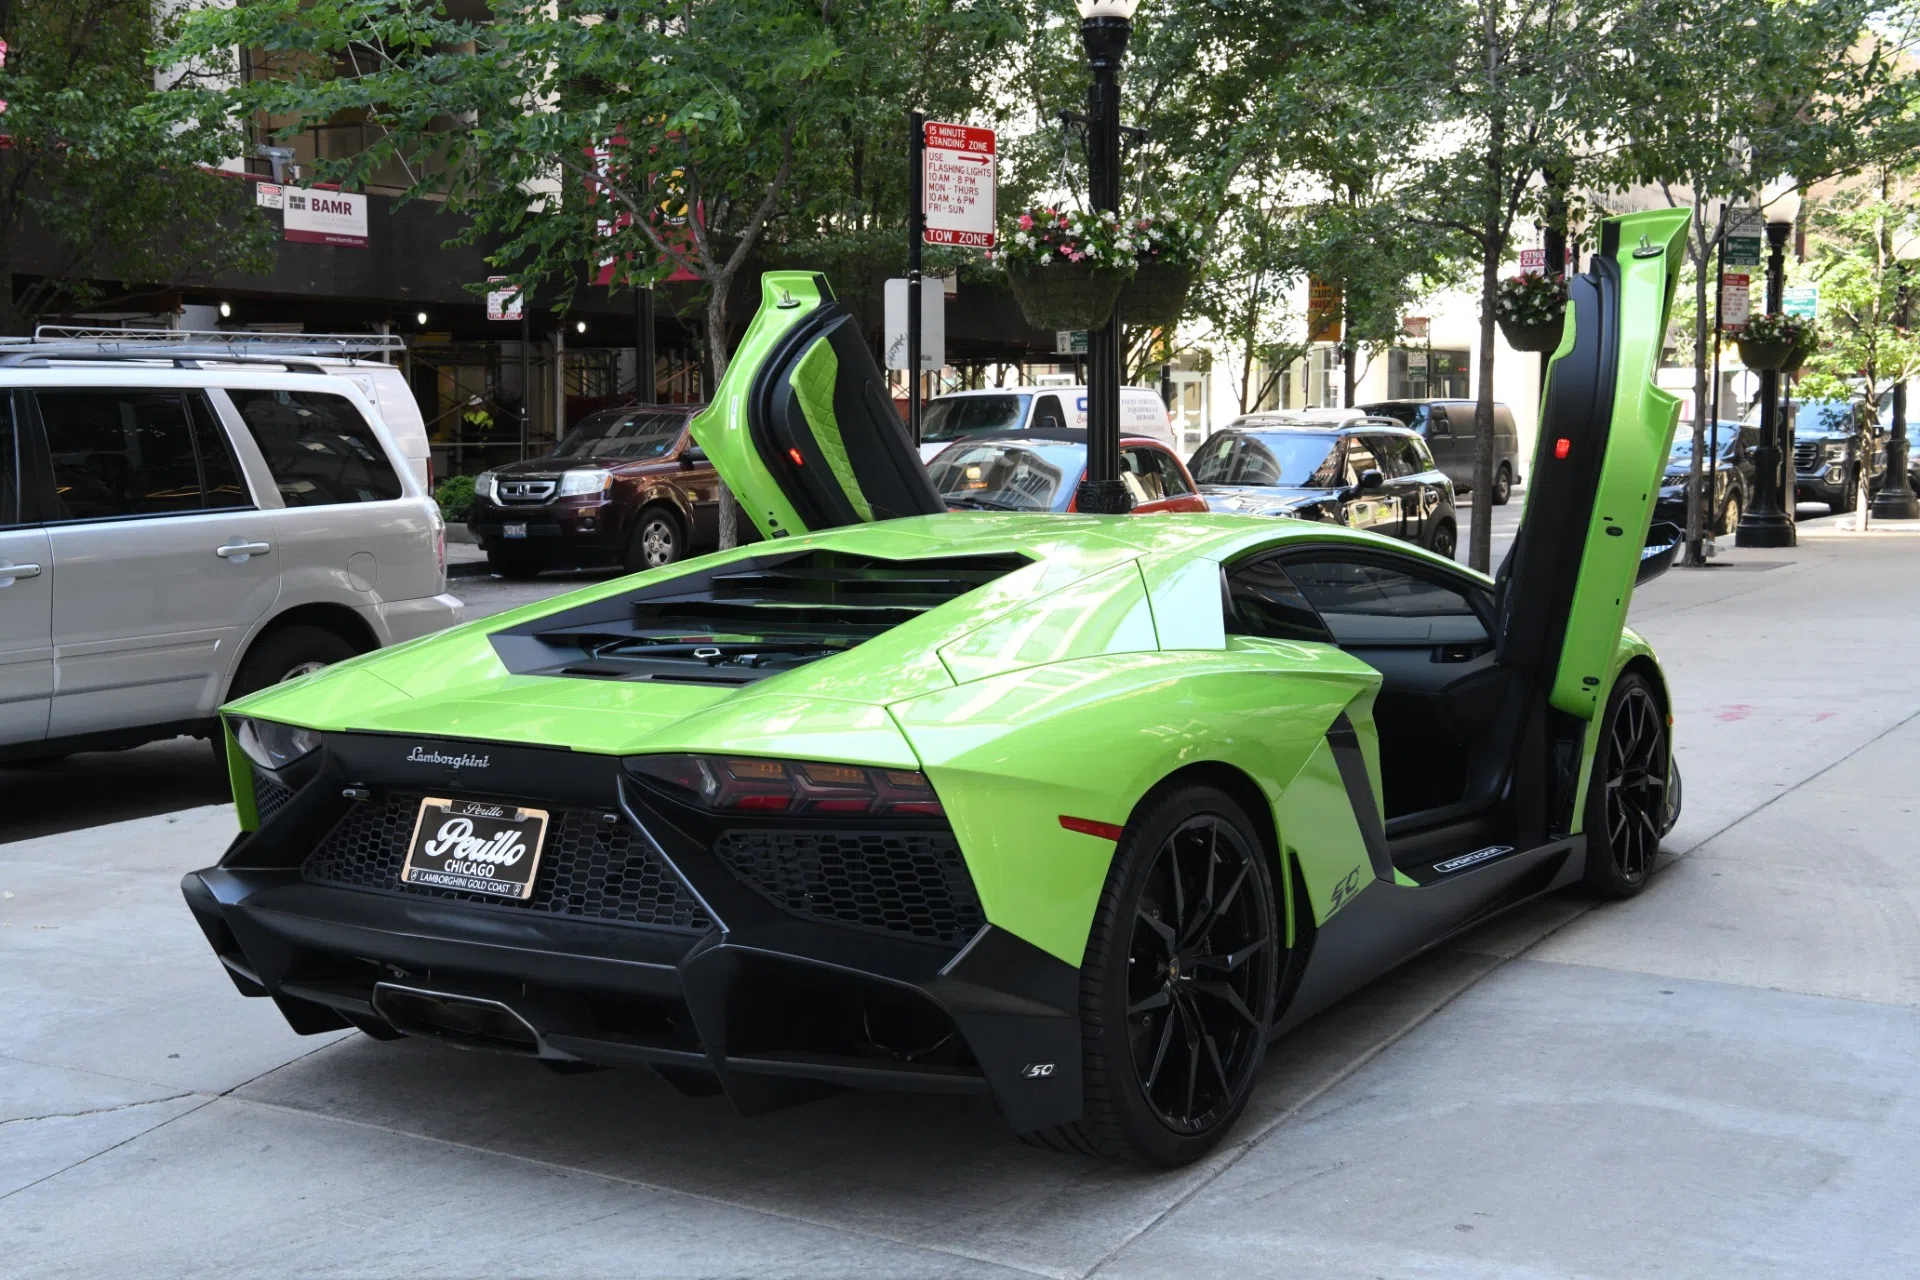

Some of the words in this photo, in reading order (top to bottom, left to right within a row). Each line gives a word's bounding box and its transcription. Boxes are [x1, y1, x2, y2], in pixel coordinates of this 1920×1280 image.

[929, 126, 937, 135] 15
[939, 127, 967, 139] MINUTE
[929, 136, 965, 149] STANDING
[968, 140, 988, 152] ZONE
[928, 152, 944, 162] USE
[928, 162, 965, 175] FLASHING
[966, 166, 992, 178] LIGHTS
[928, 183, 946, 192] MON
[954, 185, 980, 196] THURS
[311, 198, 353, 216] BAMR
[928, 203, 941, 212] FRI
[948, 204, 965, 215] SUN
[928, 229, 953, 242] TOW
[958, 232, 989, 246] ZONE
[1523, 250, 1545, 259] STRE
[407, 746, 490, 769] Lamborghini
[462, 803, 504, 817] Perillo
[424, 817, 526, 867] Perillo
[444, 859, 495, 878] CHICAGO
[419, 872, 468, 888] LAMBORGHINI
[467, 878, 487, 890] GOLD
[487, 882, 510, 894] COAST
